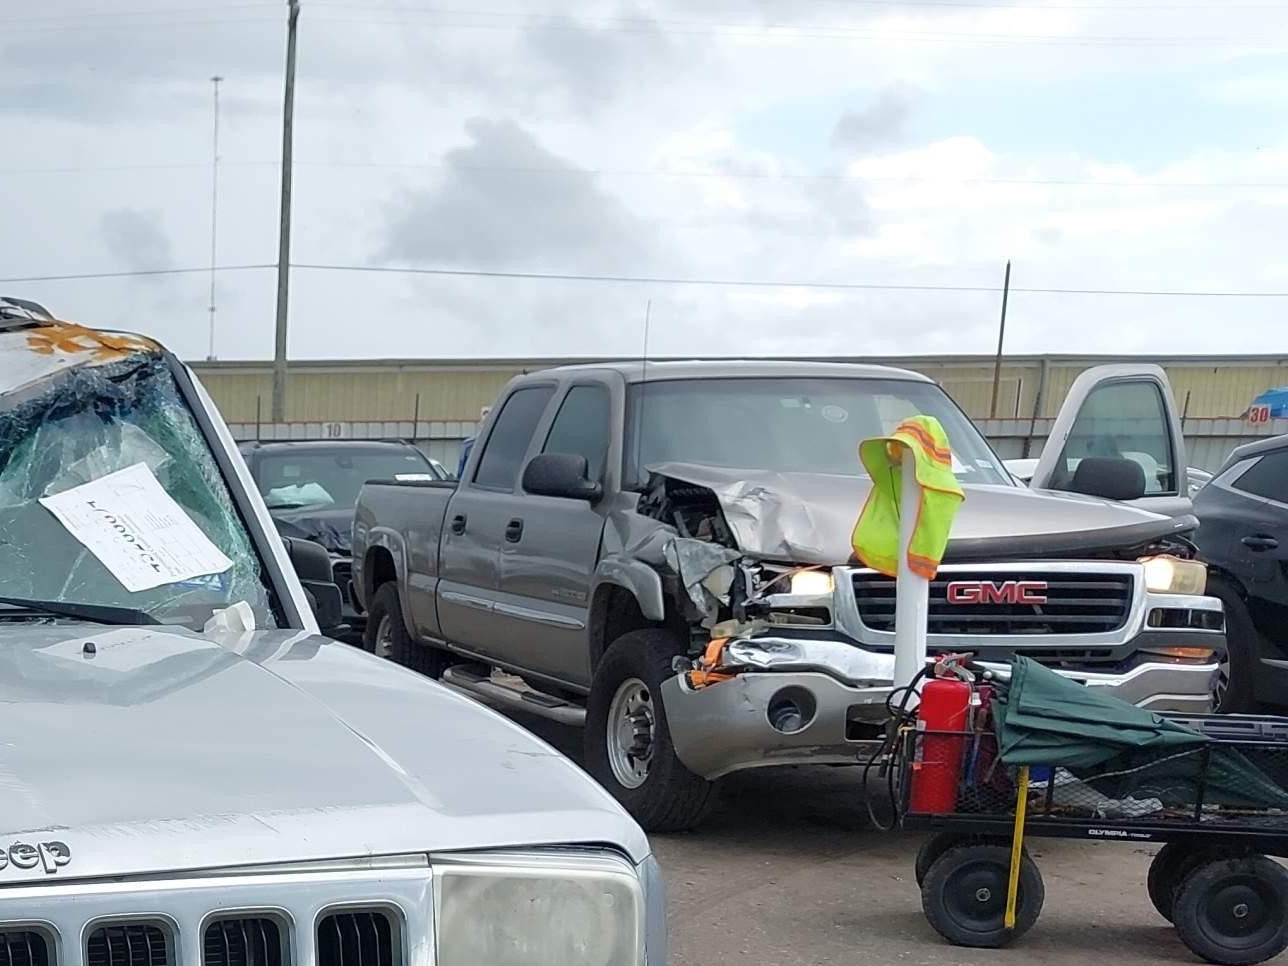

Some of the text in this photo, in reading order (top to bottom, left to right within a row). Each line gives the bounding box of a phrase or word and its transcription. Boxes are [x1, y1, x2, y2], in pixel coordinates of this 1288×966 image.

[1251, 407, 1269, 423] 30
[327, 423, 341, 438] 10
[947, 581, 1048, 604] GMC
[1088, 829, 1128, 837] OLYMPIA
